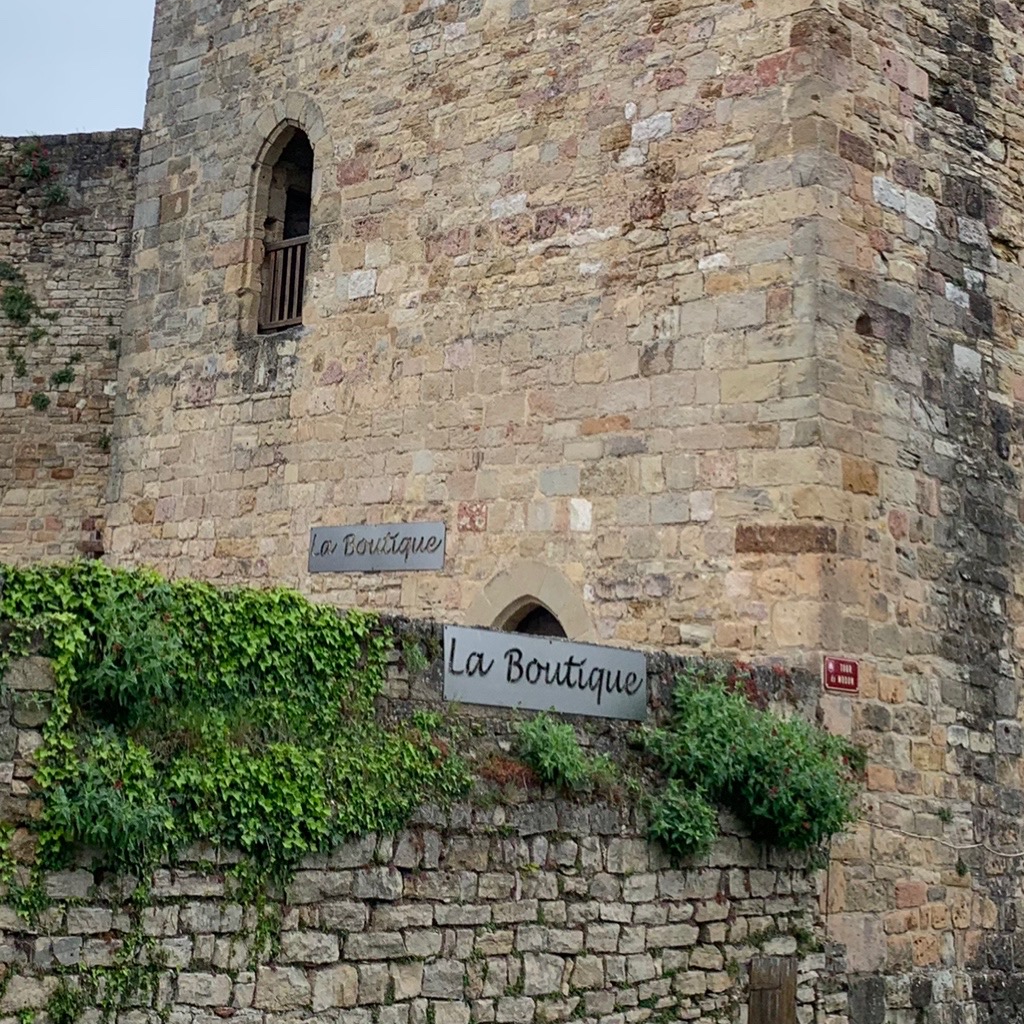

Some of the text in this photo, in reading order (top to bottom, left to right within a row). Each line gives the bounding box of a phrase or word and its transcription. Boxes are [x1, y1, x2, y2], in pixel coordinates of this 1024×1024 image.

[311, 531, 443, 564] La Boutique
[448, 637, 644, 705] La Boutique
